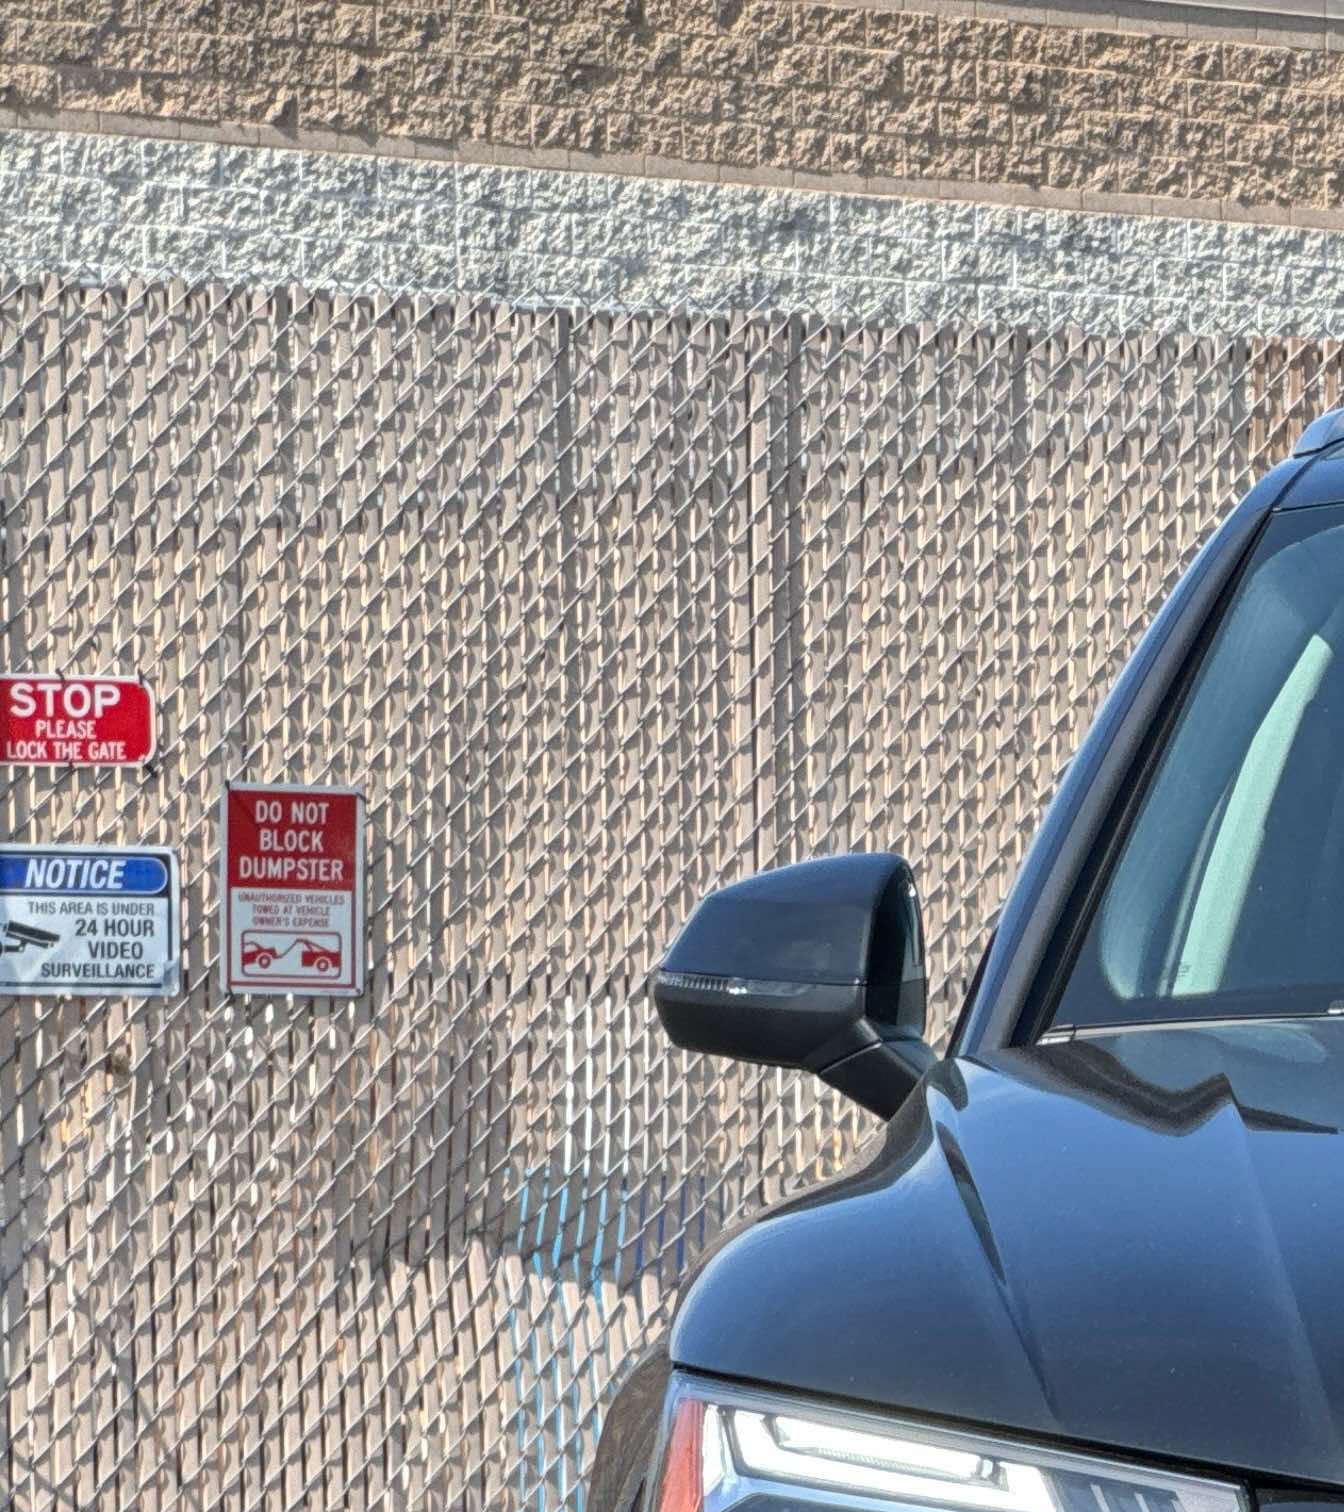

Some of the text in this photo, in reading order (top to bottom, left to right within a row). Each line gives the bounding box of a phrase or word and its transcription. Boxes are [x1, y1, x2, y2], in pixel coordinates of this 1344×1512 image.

[10, 682, 121, 718] STOP
[35, 719, 98, 739] PLEASE
[6, 740, 127, 761] LOCK THE GATE
[255, 800, 329, 825] DO NOT
[259, 828, 324, 852] BLOCK
[24, 858, 128, 889] NOTICE
[239, 855, 344, 881] DUMPSTER
[28, 901, 155, 916] THIS AREA IS UNDER
[75, 918, 155, 937] 24 HOUR
[88, 940, 144, 960] VIDEO
[41, 962, 155, 979] SURVEILLANCE
